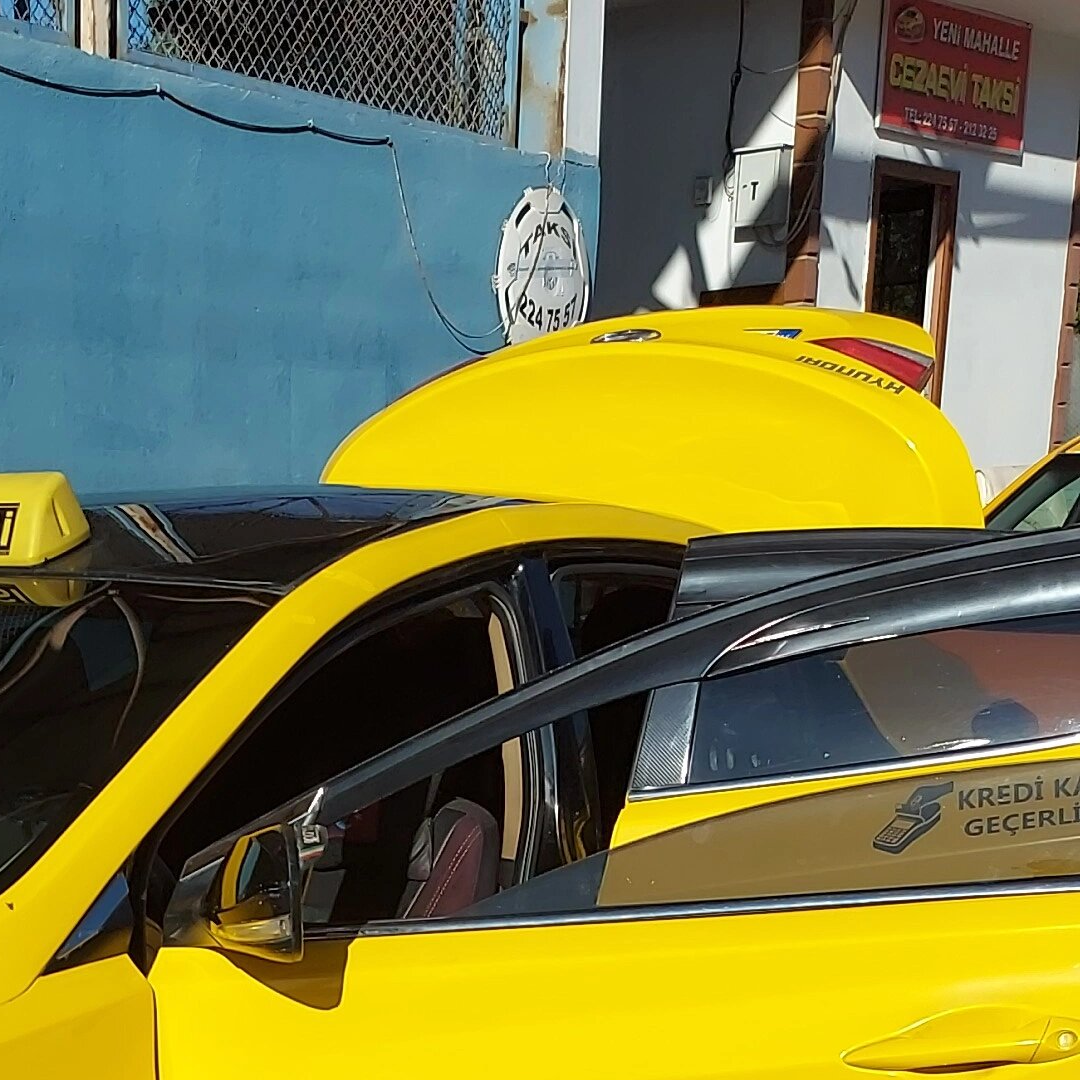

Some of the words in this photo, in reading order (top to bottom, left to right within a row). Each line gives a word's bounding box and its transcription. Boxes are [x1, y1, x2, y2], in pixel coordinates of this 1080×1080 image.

[963, 26, 1020, 60] MAHALLE
[890, 53, 967, 104] CEZAEVİ
[971, 73, 1020, 117] TAKSİ
[520, 294, 542, 331] 224
[547, 308, 560, 332] 75
[563, 293, 577, 327] 57
[795, 355, 905, 395] HYUNDAI
[958, 776, 1043, 810] KREDİ
